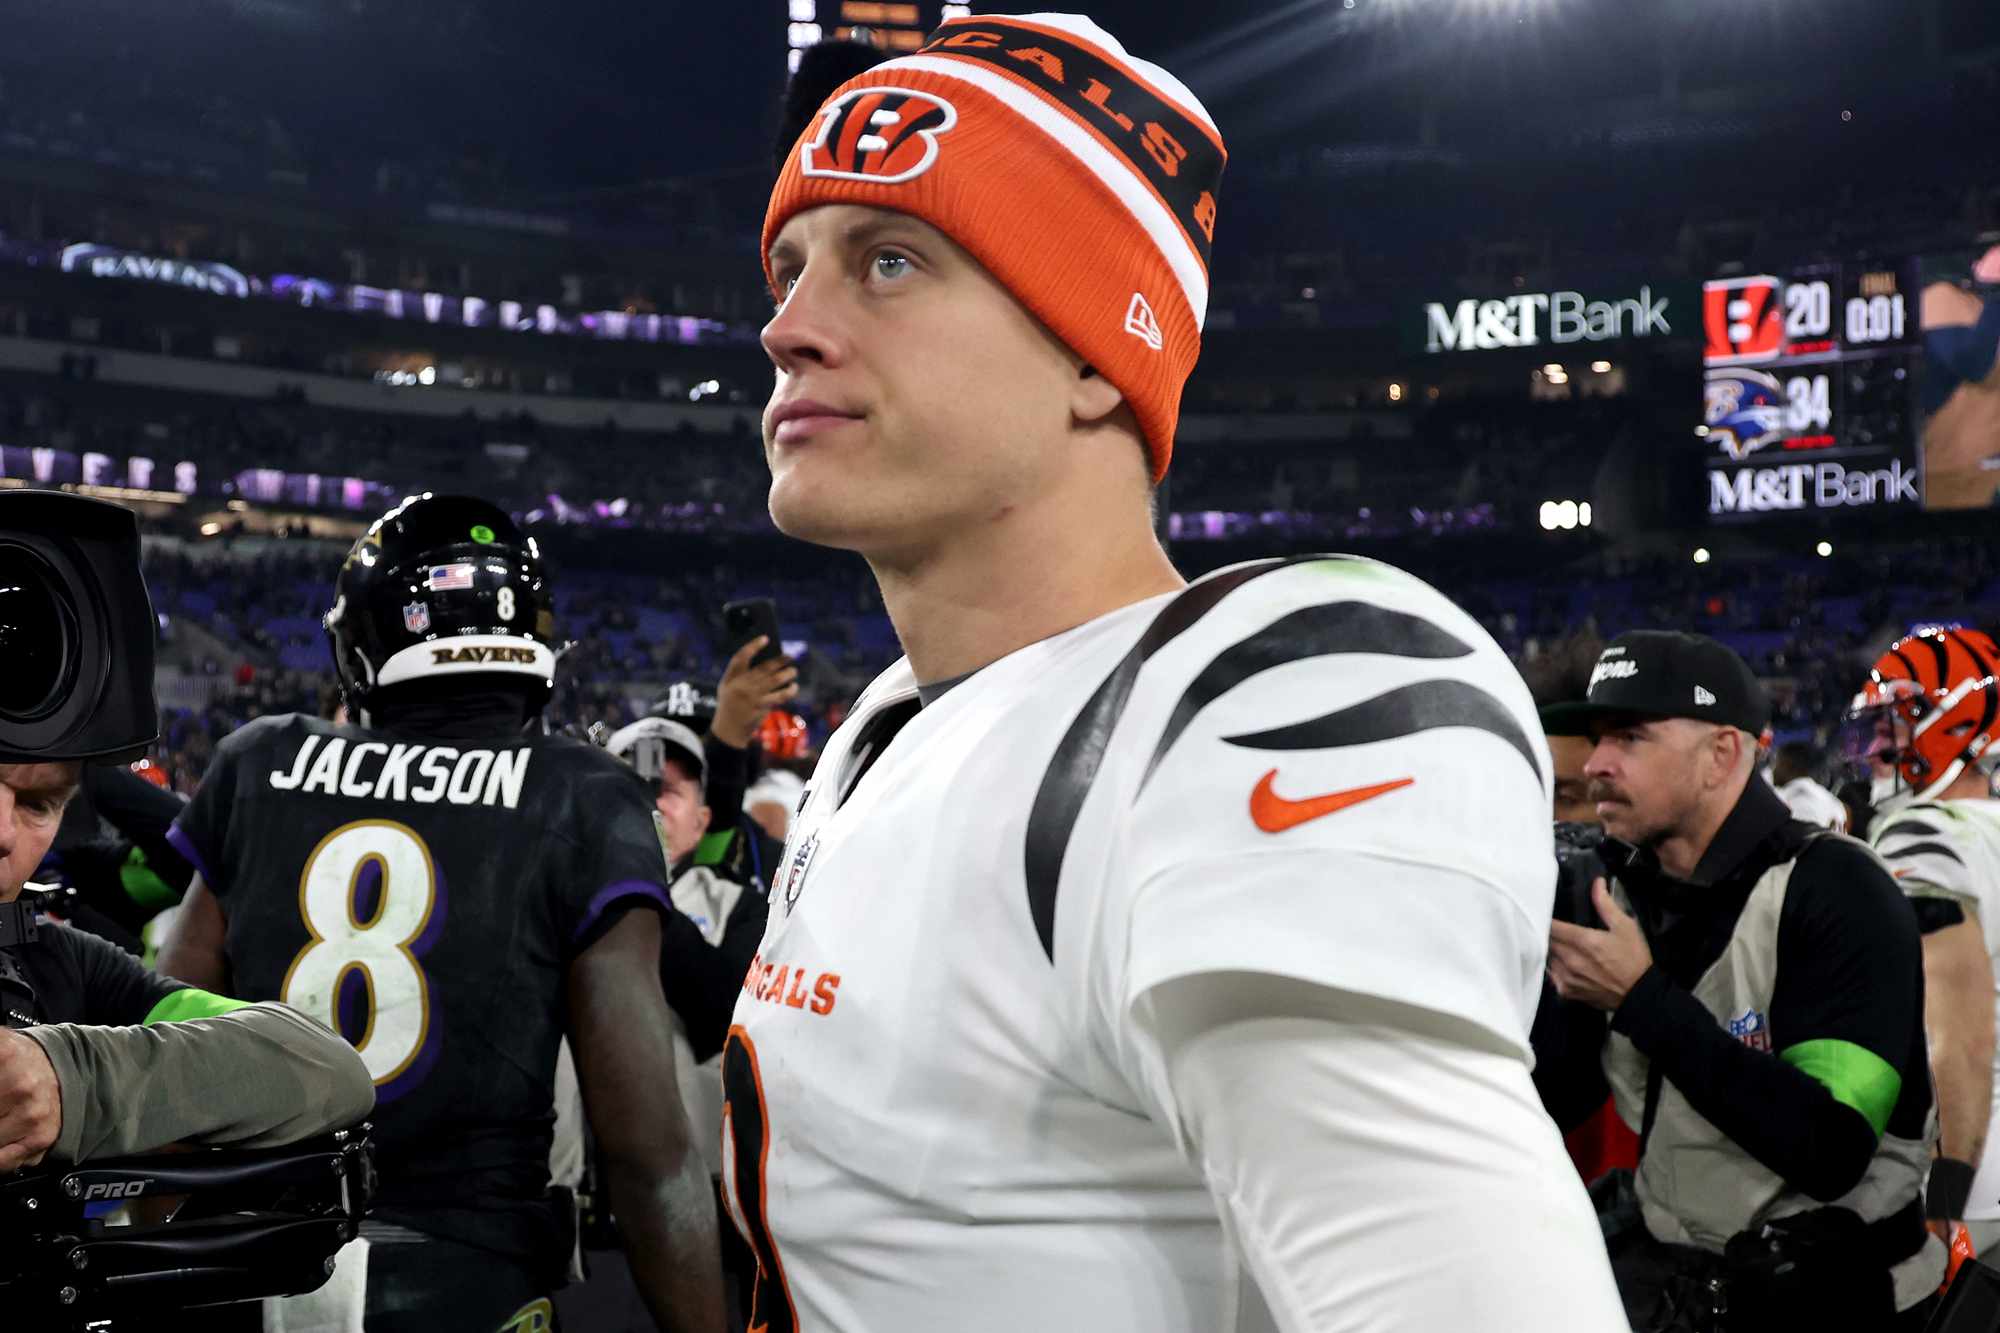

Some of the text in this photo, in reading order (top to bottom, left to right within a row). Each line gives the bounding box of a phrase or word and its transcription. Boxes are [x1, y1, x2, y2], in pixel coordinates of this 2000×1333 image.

[1424, 284, 1672, 353] M&T Bank
[1785, 280, 1831, 338] 20
[1786, 374, 1832, 431] 34
[1708, 457, 1919, 513] M&T Bank
[497, 586, 516, 621] 8
[430, 647, 537, 665] RAVENS
[269, 734, 532, 809] JACKSON
[280, 819, 437, 1087] 8
[84, 1181, 145, 1200] PRO
